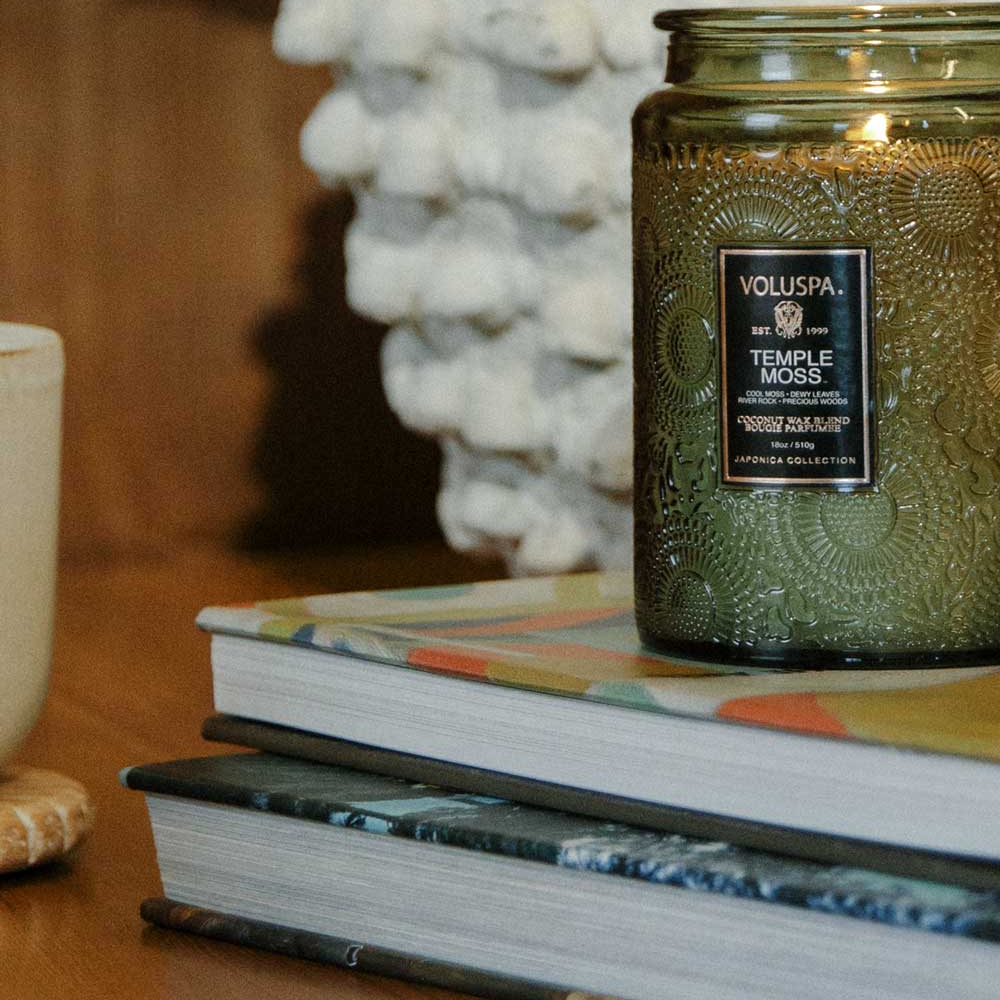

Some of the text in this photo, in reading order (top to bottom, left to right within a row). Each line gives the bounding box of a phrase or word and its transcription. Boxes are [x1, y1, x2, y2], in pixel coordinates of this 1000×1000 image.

[751, 326, 829, 335] EST. 1999
[750, 349, 834, 366] TEMPLE
[760, 367, 822, 384] MOSS
[745, 390, 764, 398] COOL
[765, 390, 785, 398] MOSS
[758, 397, 778, 405] ROCK
[737, 416, 851, 425] COCONUT WAX BLEND
[745, 424, 783, 433] BOUGIE
[770, 441, 789, 449] 18oz
[794, 441, 815, 450] 510g
[734, 455, 857, 465] JAPONICA COLLECTION
